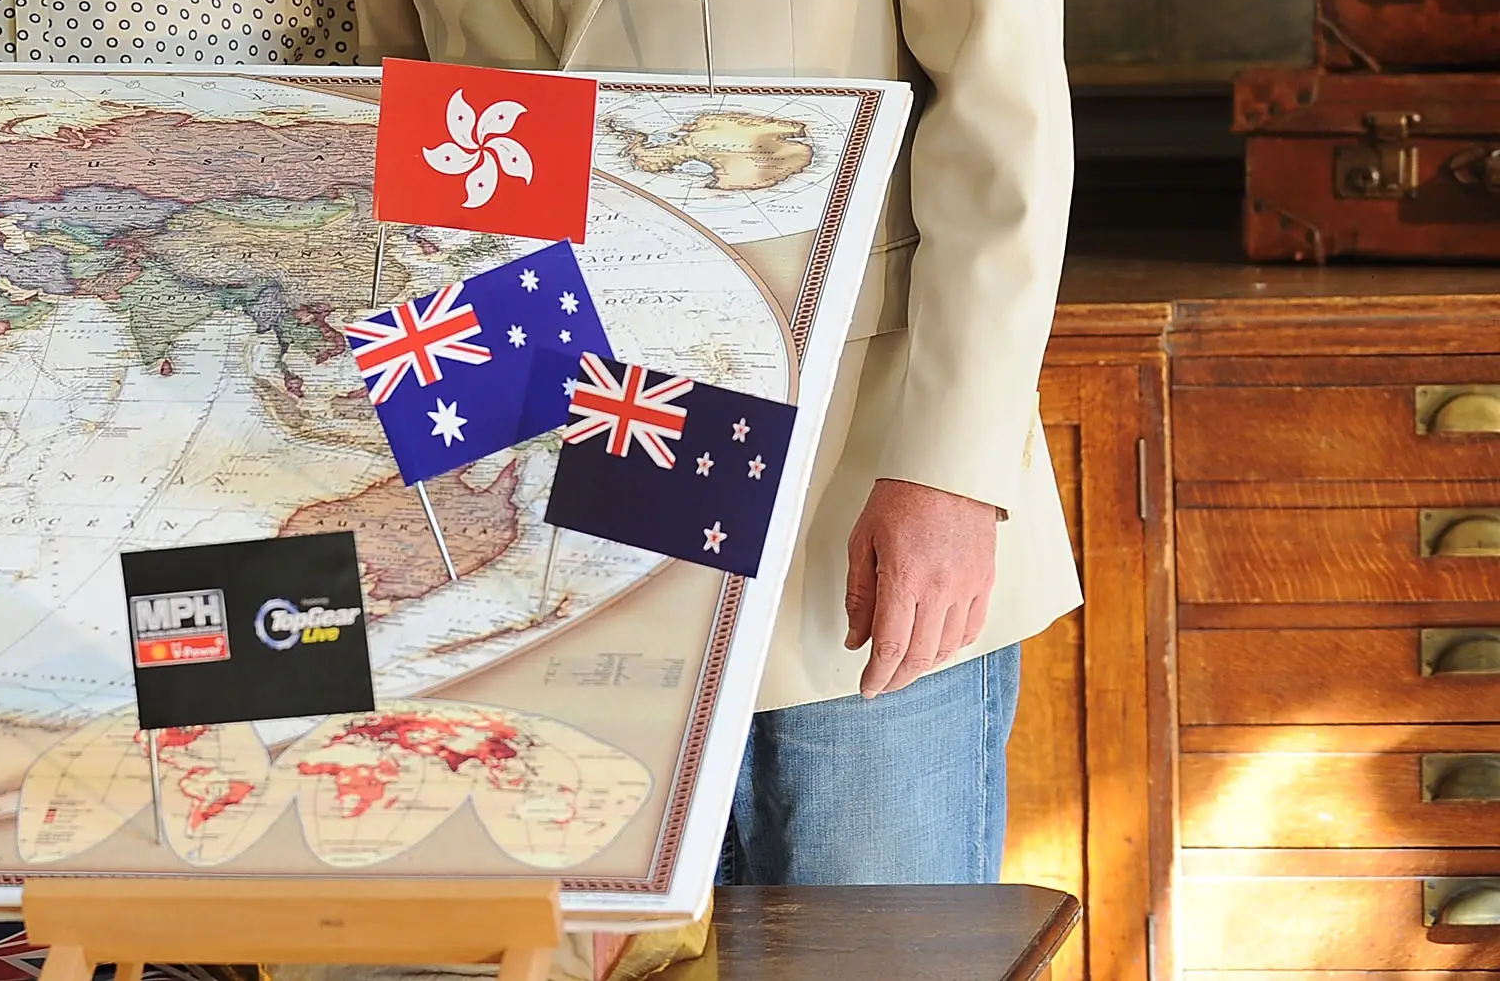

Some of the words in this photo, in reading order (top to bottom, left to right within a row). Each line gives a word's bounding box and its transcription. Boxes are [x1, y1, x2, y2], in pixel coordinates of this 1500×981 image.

[27, 153, 326, 170] RUSSIA
[579, 251, 669, 264] ACIFIC
[604, 295, 685, 306] OCEAN
[11, 516, 179, 531] OCEAN
[315, 518, 488, 535] AUSTRALIA
[135, 594, 222, 631] MPH
[271, 606, 362, 632] TopGear
[300, 626, 341, 644] Live
